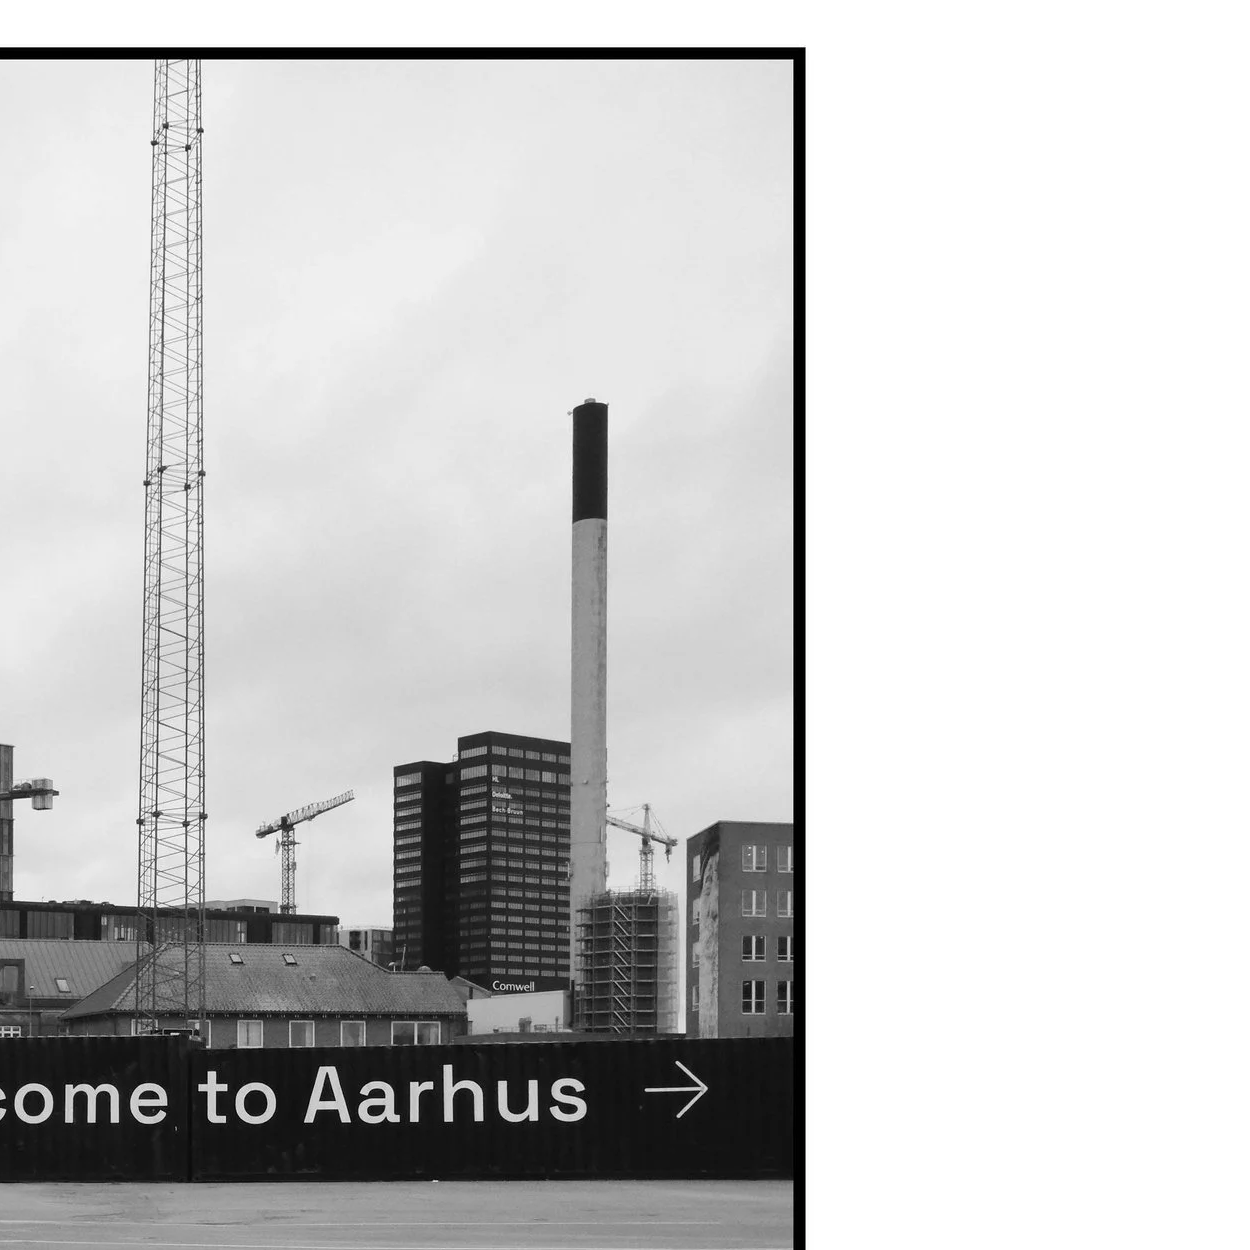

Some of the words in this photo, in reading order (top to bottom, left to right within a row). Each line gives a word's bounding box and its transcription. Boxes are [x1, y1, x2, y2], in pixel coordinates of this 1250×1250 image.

[492, 980, 535, 992] Comwell
[197, 1070, 277, 1125] to
[303, 1064, 588, 1124] Aarhus
